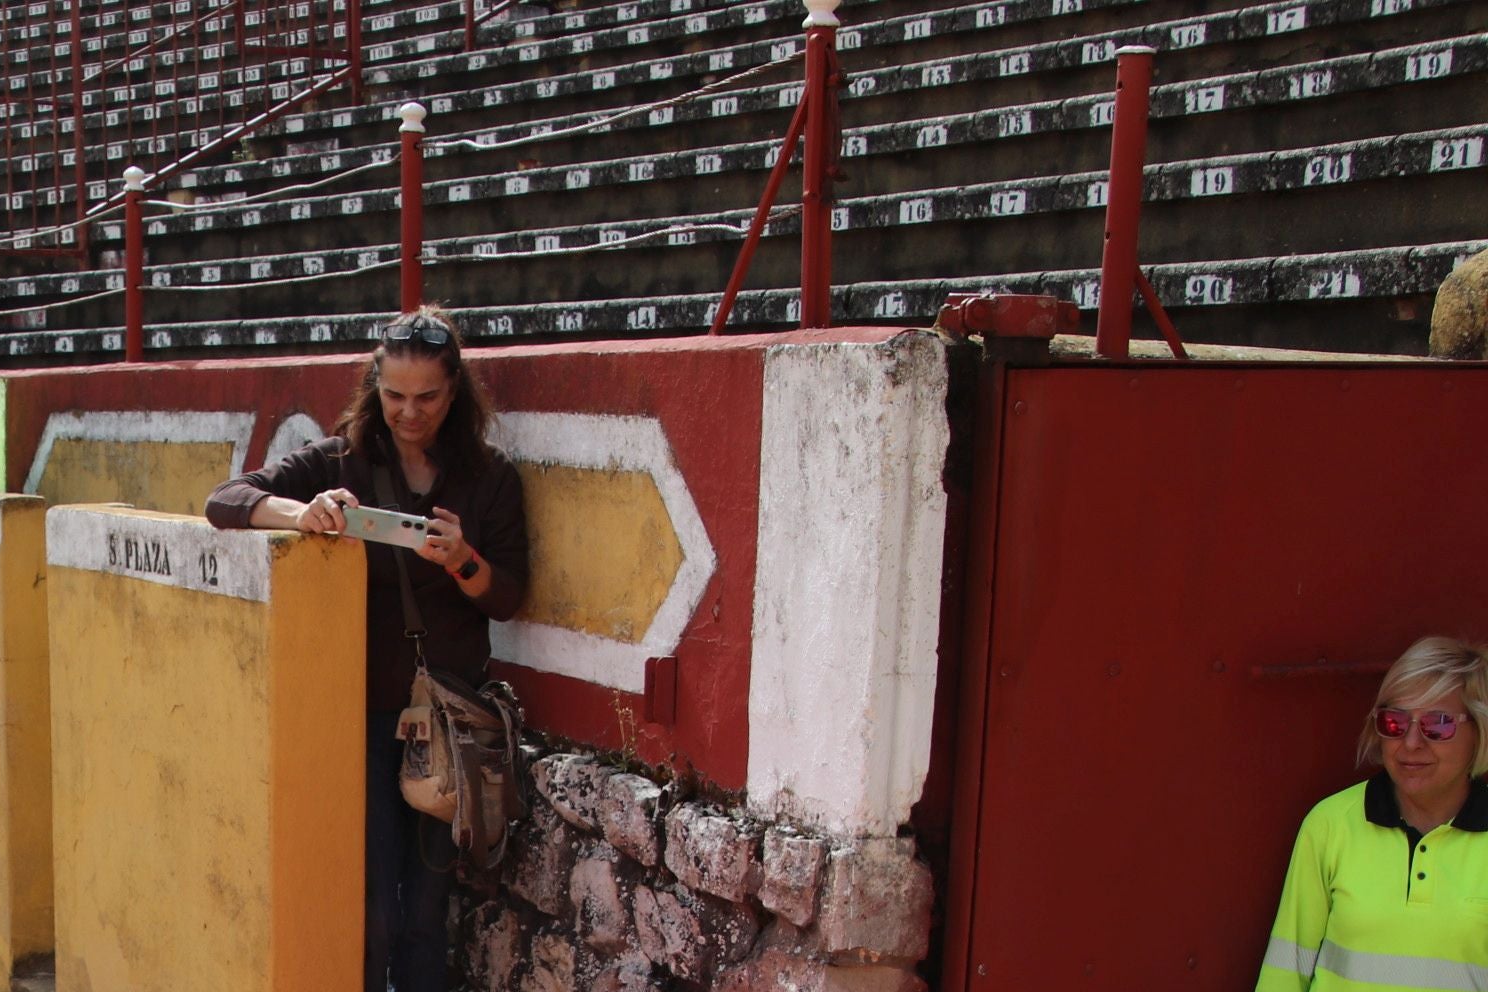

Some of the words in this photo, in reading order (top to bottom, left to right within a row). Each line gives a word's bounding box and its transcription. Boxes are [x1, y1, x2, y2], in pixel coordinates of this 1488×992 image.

[1271, 10, 1298, 32] 17
[1176, 29, 1199, 47] 16
[1004, 55, 1025, 73] 14
[1412, 55, 1441, 78] 19
[717, 100, 733, 115] 10
[1191, 90, 1216, 112] 17
[1003, 115, 1024, 135] 15
[1439, 144, 1470, 168] 21
[1311, 157, 1344, 181] 20
[1200, 172, 1227, 194] 19
[905, 201, 927, 221] 16
[996, 194, 1019, 215] 17
[1191, 279, 1225, 303] 20
[124, 538, 172, 576] PLAZA
[198, 552, 218, 586] 12
